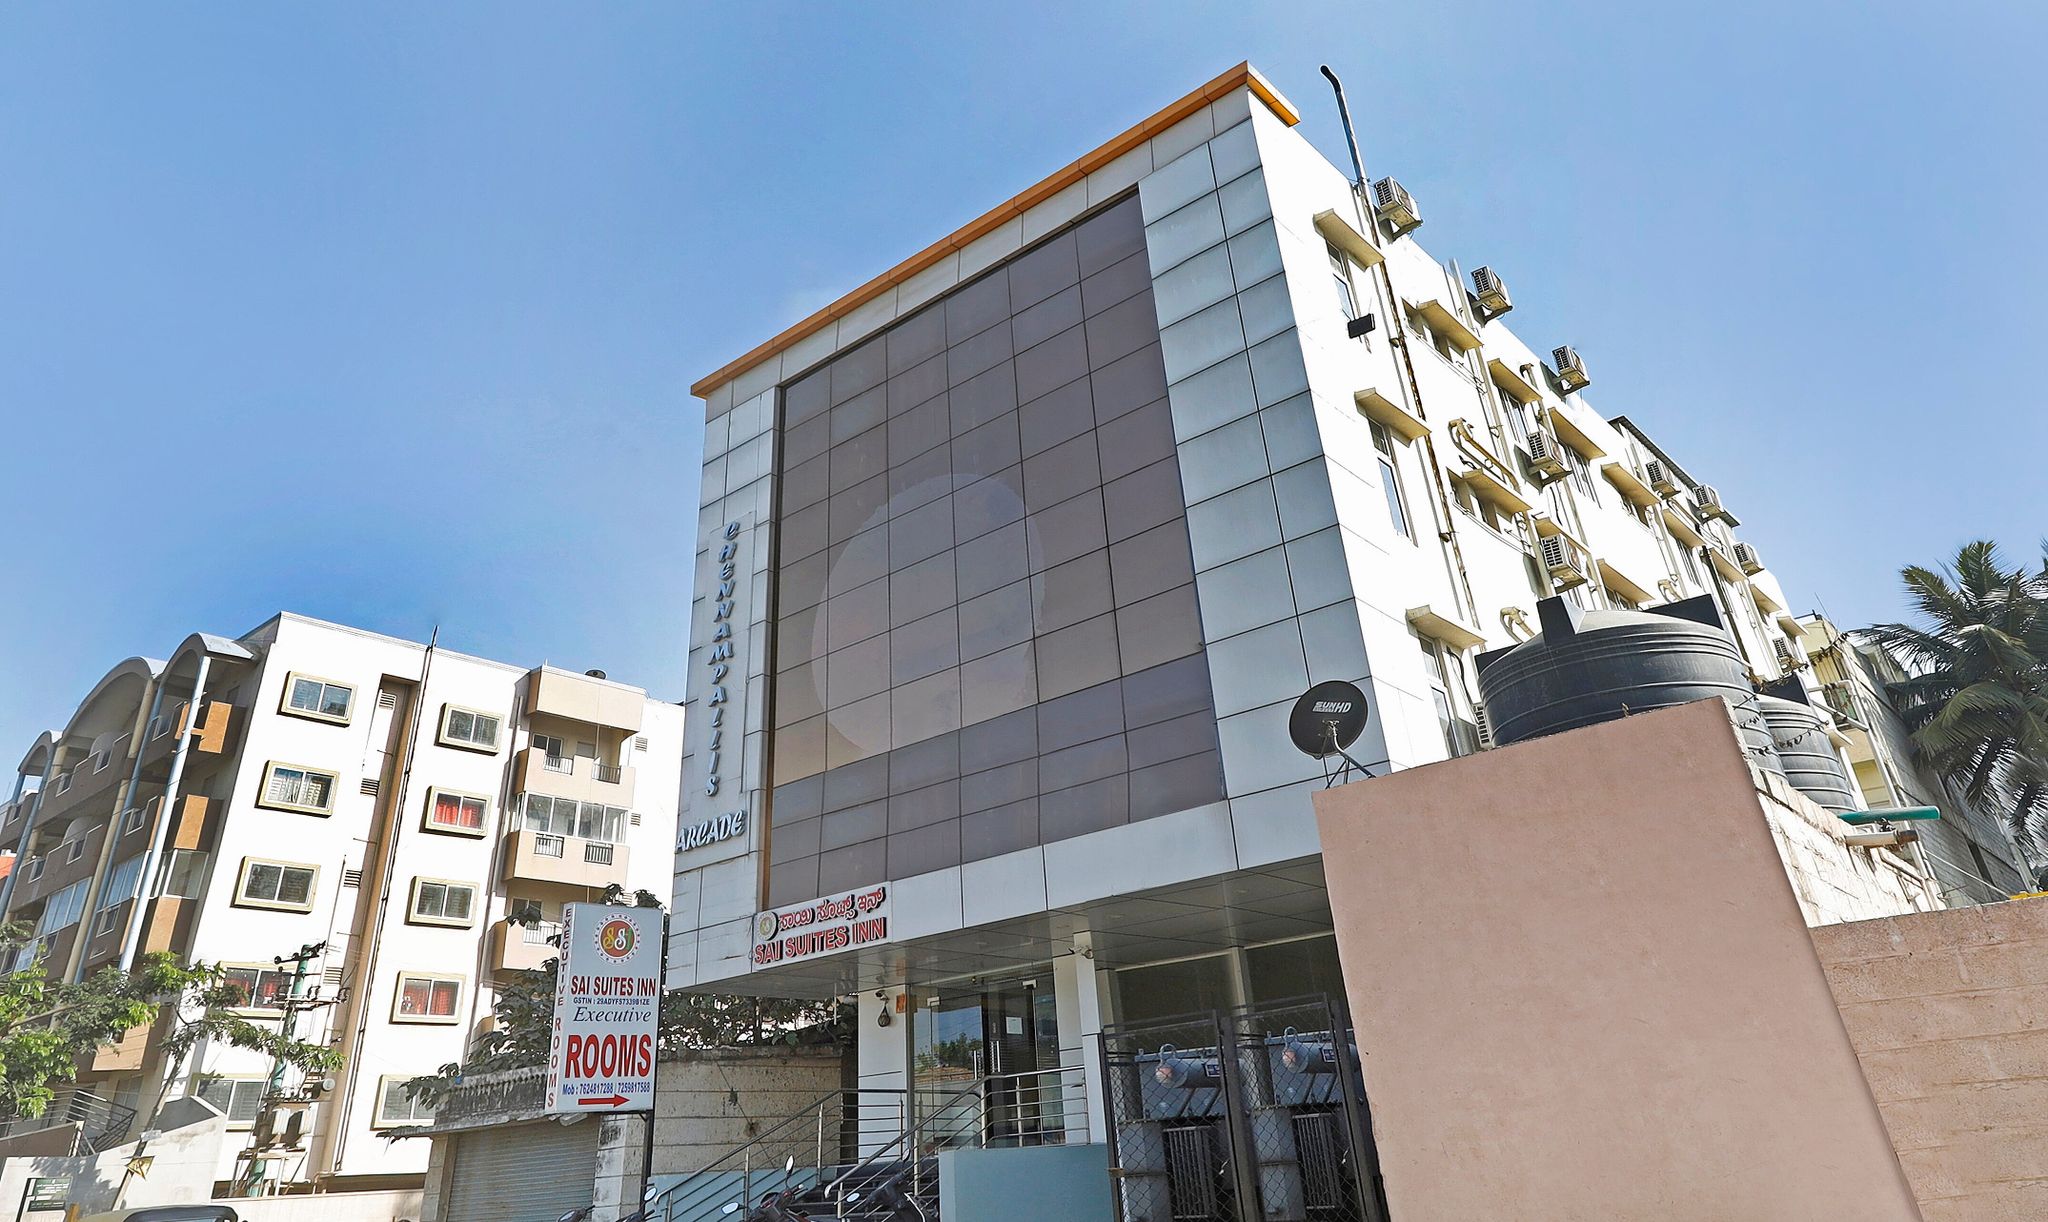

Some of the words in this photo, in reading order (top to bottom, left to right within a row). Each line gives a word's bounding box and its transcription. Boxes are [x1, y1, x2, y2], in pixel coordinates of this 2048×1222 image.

[675, 810, 746, 854] ARCADE
[779, 907, 814, 931] ಸಾಯಿ
[557, 908, 573, 1007] EXECUTIVE
[754, 939, 783, 965] SAI
[785, 926, 850, 959] SUITES
[852, 917, 887, 943] INN
[570, 975, 591, 996] SAI
[593, 976, 634, 997] SUITES
[636, 977, 657, 997] INN
[573, 996, 592, 1005] GSTIN
[572, 1005, 652, 1023] Executive
[547, 1016, 562, 1108] ROOMS
[564, 1033, 652, 1079] ROOMS
[562, 1083, 575, 1095] Mob
